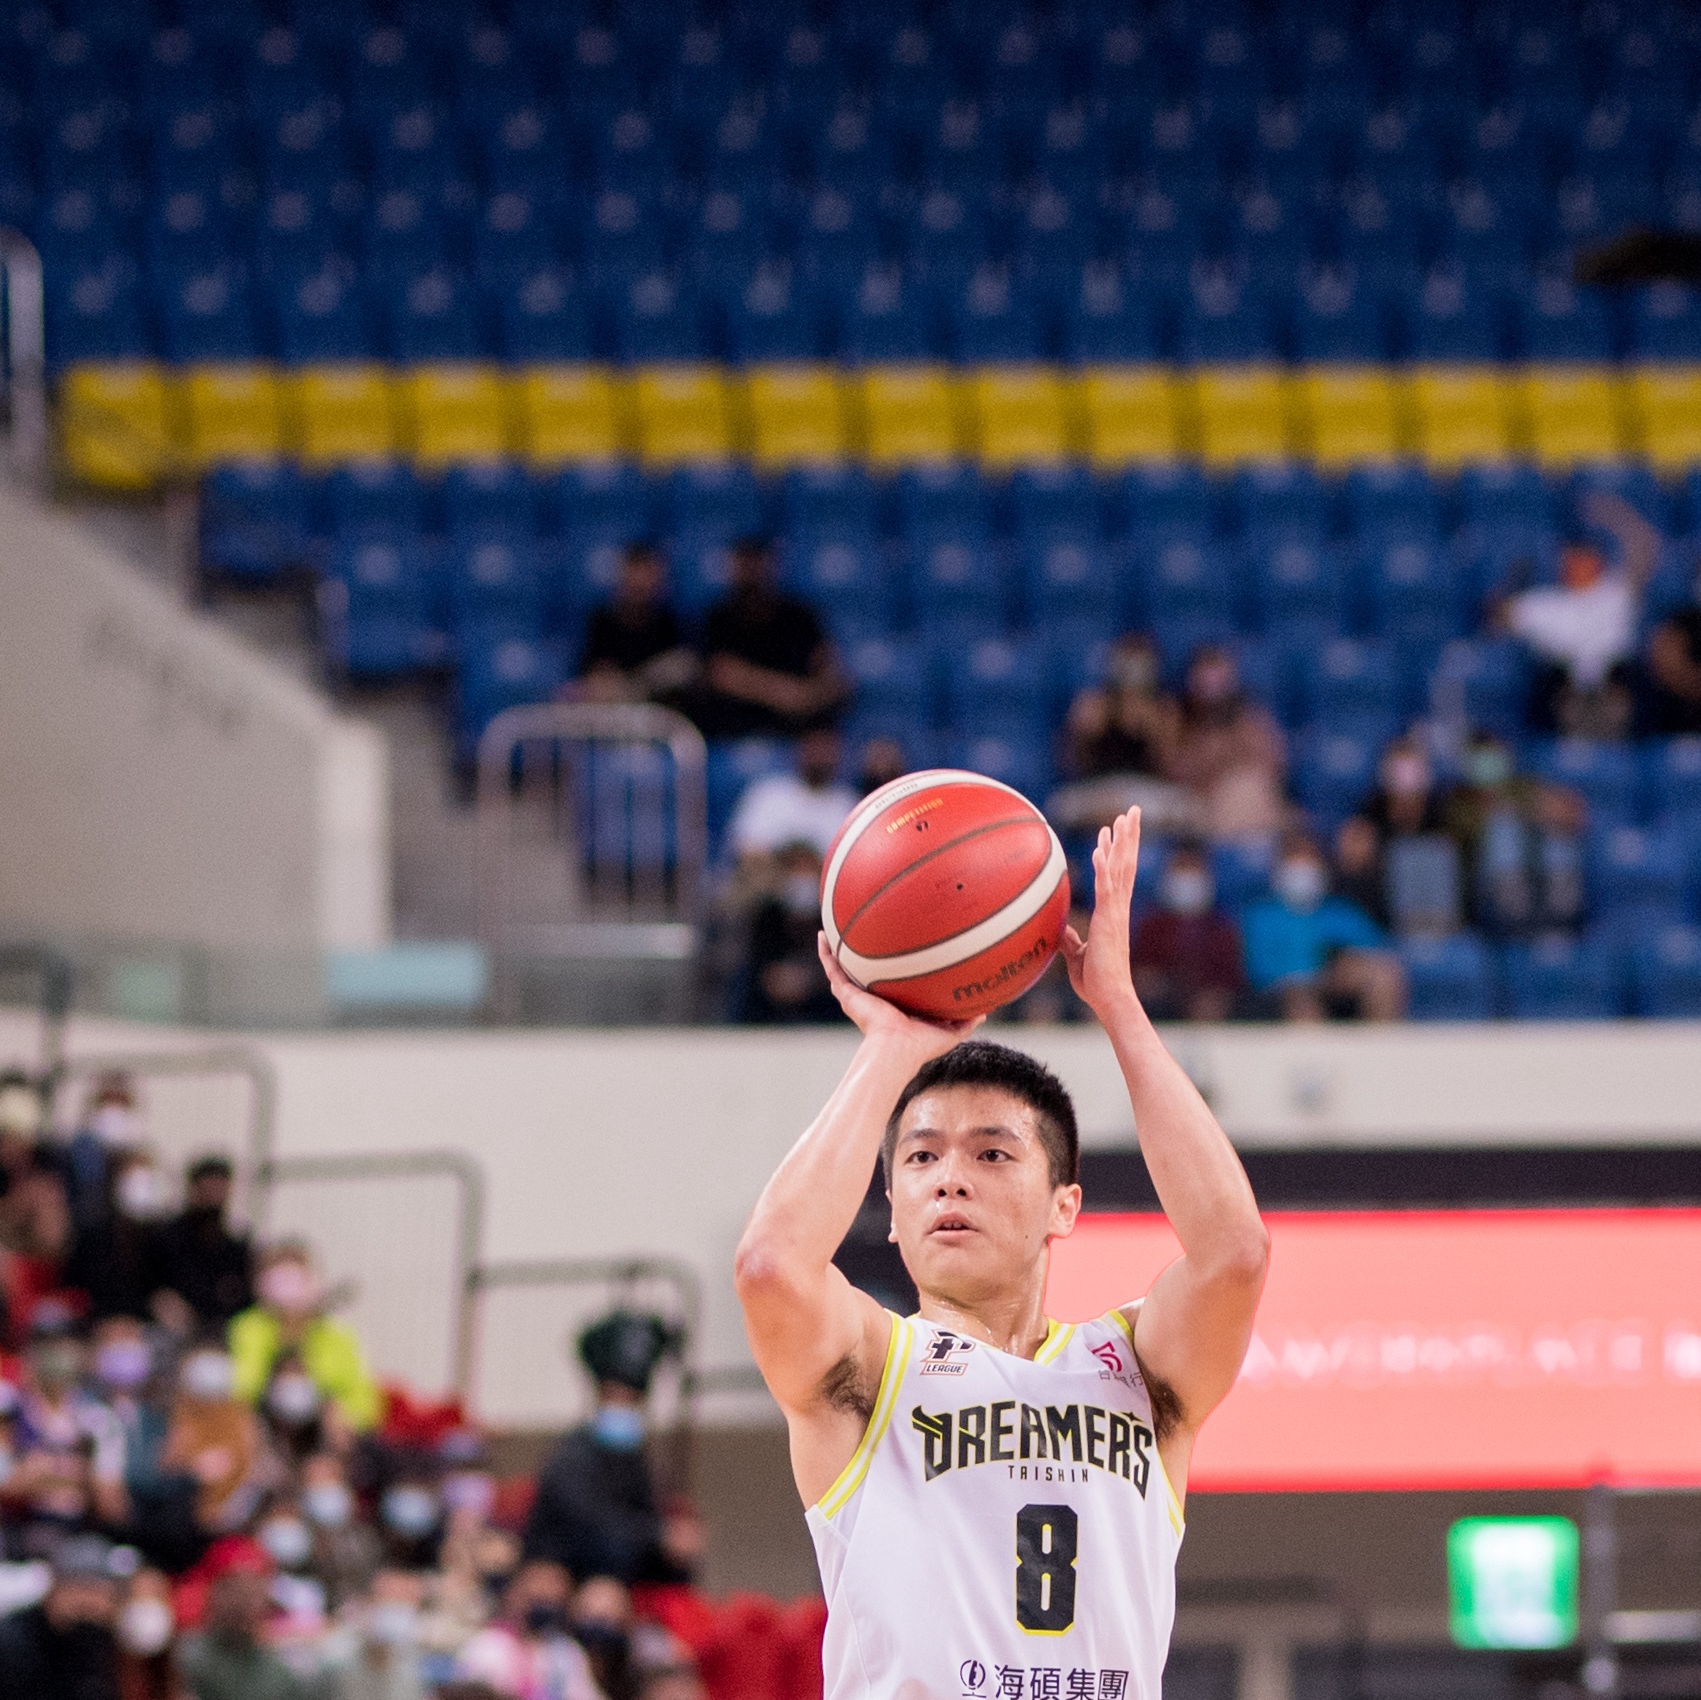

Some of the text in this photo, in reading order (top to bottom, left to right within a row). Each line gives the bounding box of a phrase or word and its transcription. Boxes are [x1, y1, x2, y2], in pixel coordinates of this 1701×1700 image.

[952, 936, 1047, 1002] molten
[926, 1364, 964, 1374] LEAGUE
[911, 1400, 1154, 1501] DREAMERS
[1007, 1464, 1090, 1484] TAISHIN
[1016, 1503, 1079, 1636] 8
